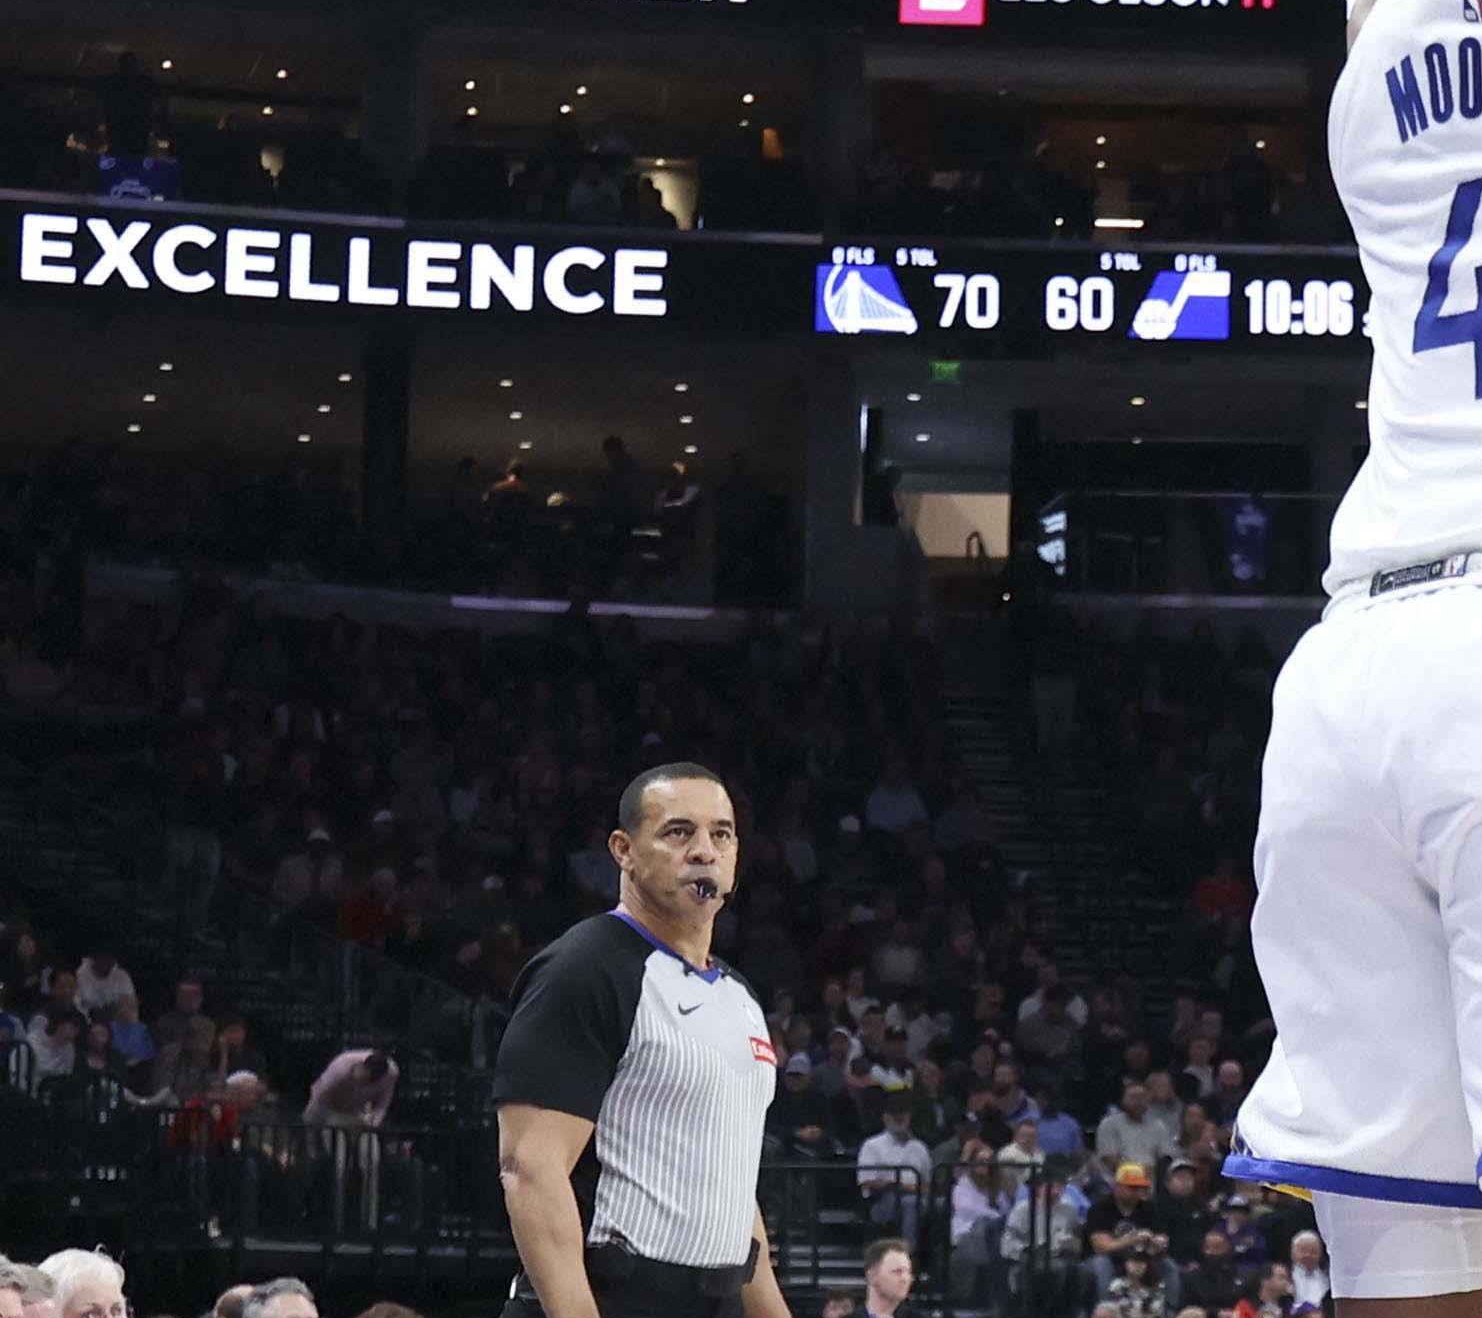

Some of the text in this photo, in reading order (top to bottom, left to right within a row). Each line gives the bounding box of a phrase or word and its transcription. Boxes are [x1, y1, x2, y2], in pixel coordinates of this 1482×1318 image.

[20, 213, 668, 316] EXCELLENCE
[933, 273, 1354, 336] 70 60 10:06
